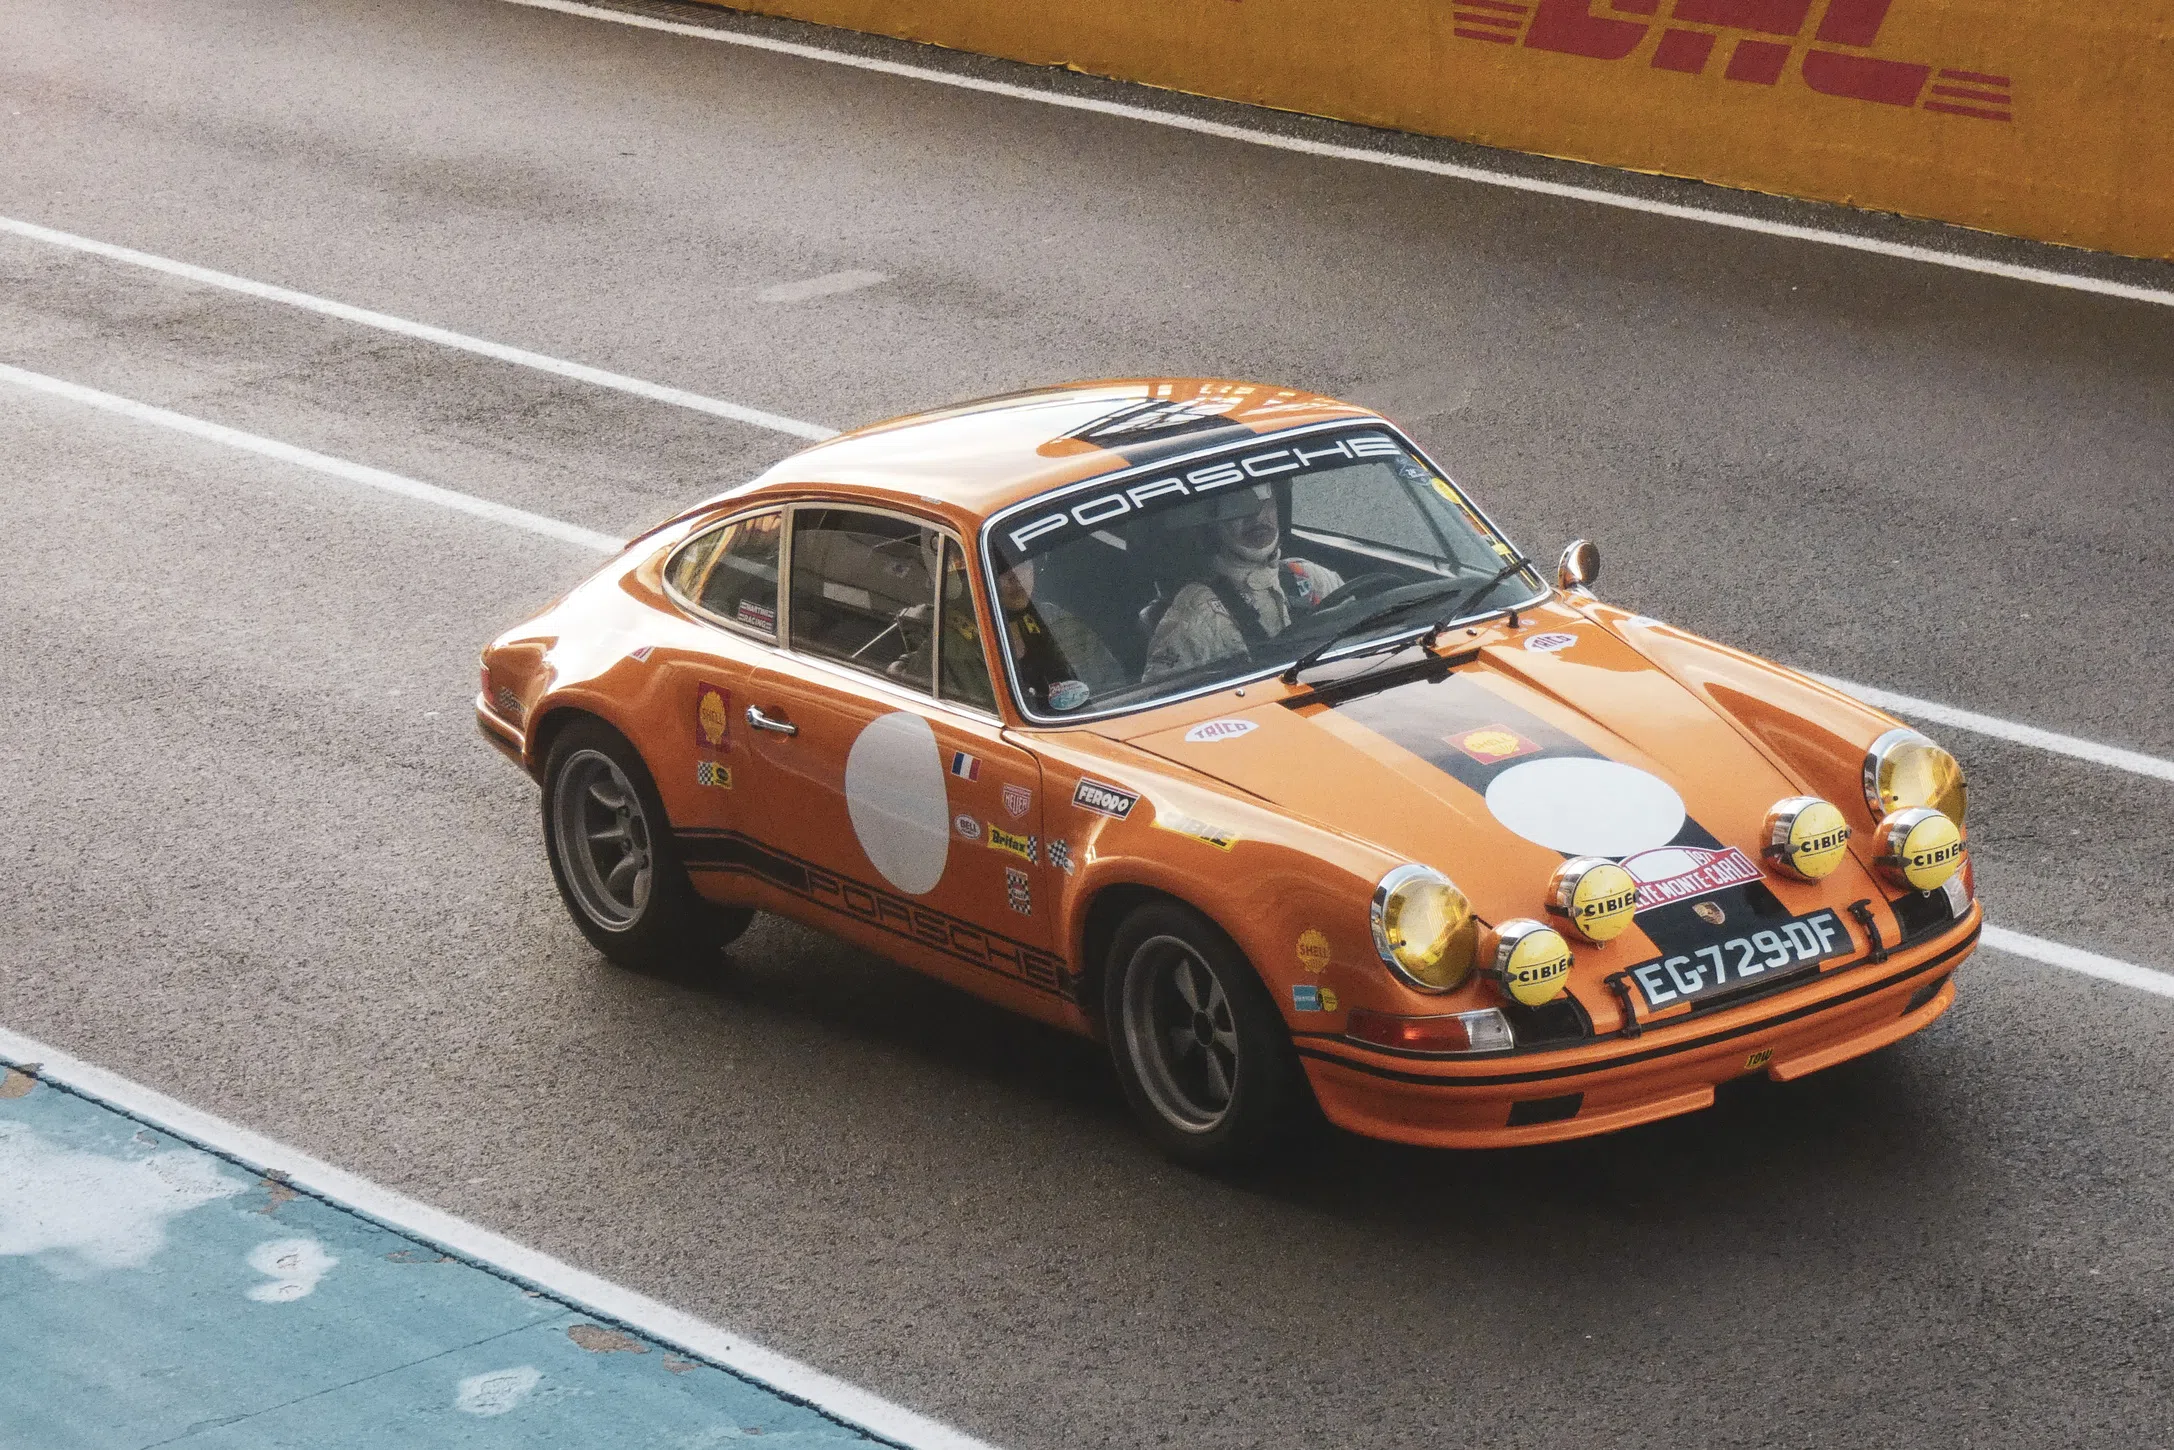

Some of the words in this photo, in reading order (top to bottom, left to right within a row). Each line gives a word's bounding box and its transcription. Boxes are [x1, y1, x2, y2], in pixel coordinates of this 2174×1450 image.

[1009, 437, 1401, 552] PORSCHE
[1195, 722, 1248, 739] TRICO
[1005, 791, 1028, 814] HEUER
[1078, 786, 1130, 812] FERODO
[960, 819, 977, 832] BELL
[992, 829, 1026, 853] Britax
[1655, 851, 1758, 899] MONTE-CARLO
[806, 869, 1056, 986] PORSCHE
[1299, 945, 1328, 958] SHELL
[1634, 914, 1835, 1005] EG-729-DF
[1746, 1048, 1773, 1067] TOW
